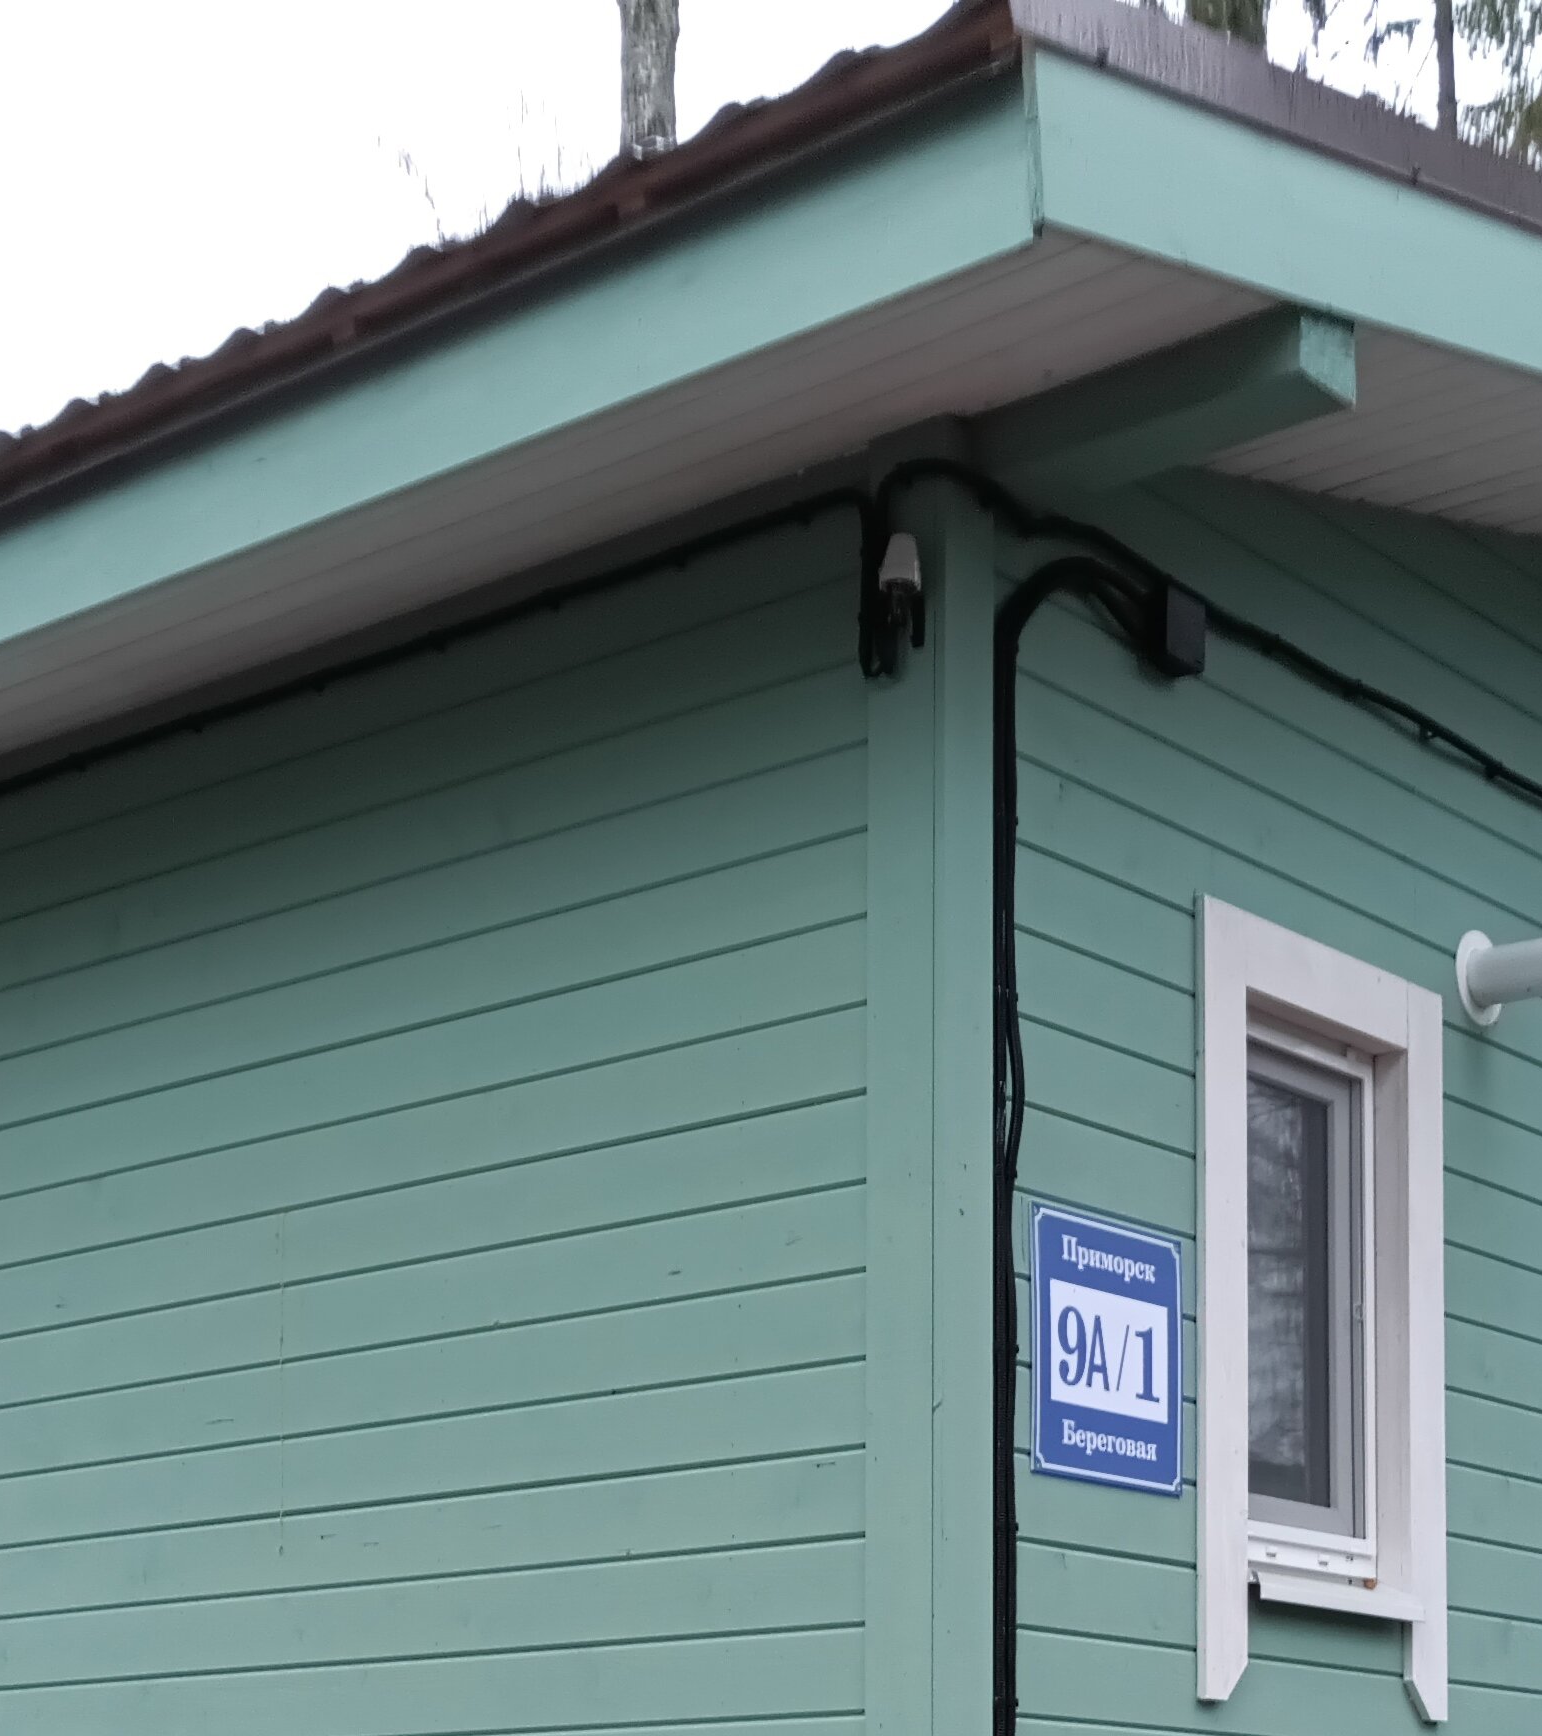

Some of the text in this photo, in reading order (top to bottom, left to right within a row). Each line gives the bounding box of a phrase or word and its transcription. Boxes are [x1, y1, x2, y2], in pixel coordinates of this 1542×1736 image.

[1061, 1233, 1156, 1284] Приморск
[1057, 1305, 1160, 1403] 9А/1
[1061, 1418, 1157, 1462] Береговая
